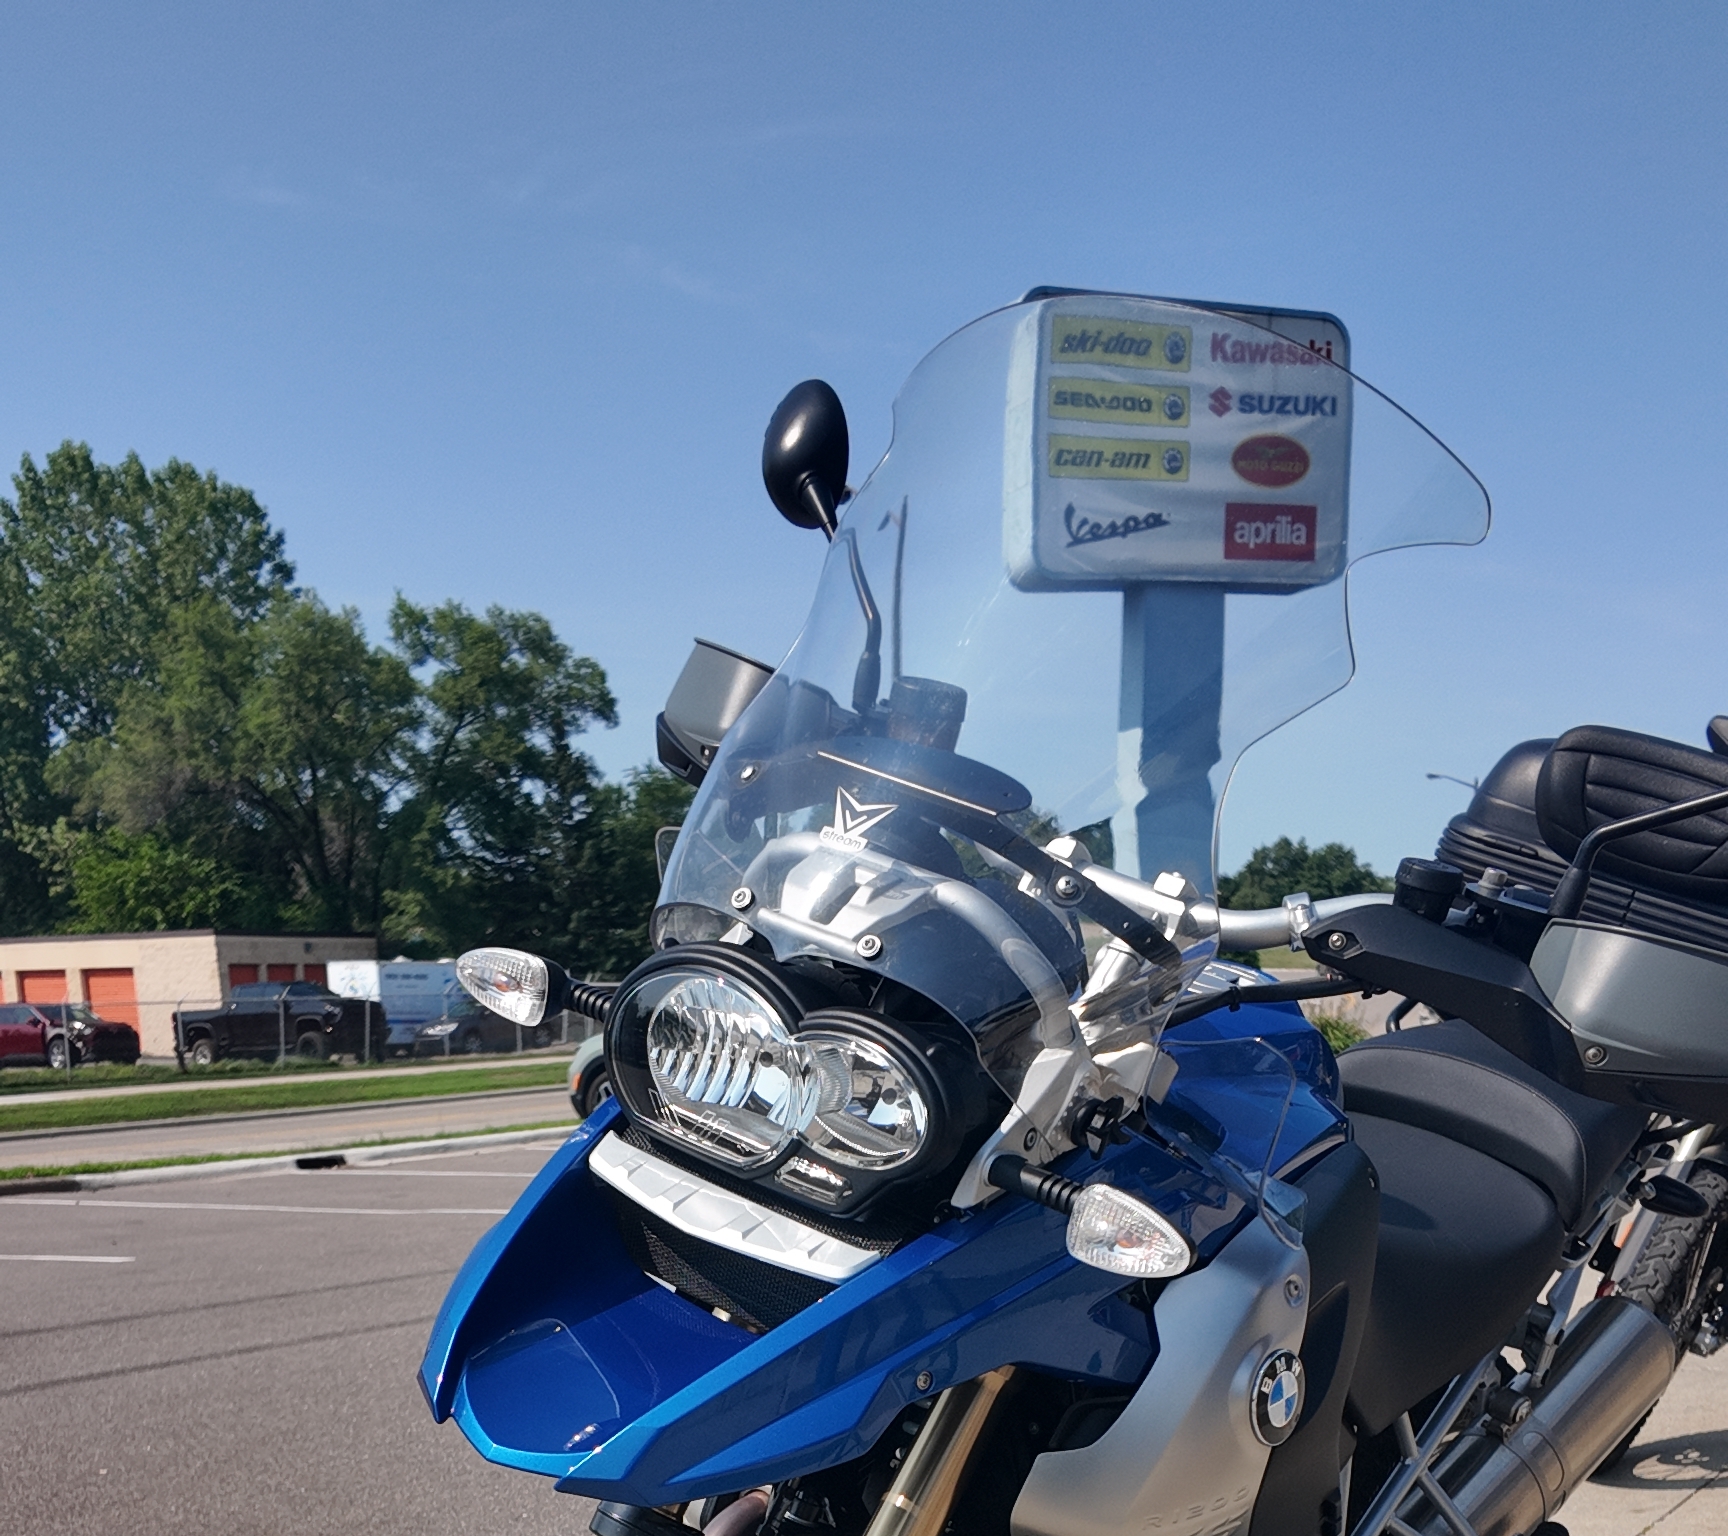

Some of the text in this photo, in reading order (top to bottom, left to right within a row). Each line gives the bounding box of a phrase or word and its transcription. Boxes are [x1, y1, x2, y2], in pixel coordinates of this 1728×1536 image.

[1060, 329, 1152, 357] ski-doo
[1209, 332, 1333, 367] Kawasaki
[1238, 394, 1337, 417] SUZUKI
[1054, 448, 1151, 469] can-am
[1064, 501, 1171, 548] Vespa
[1233, 515, 1307, 549] aprilia
[1260, 1356, 1302, 1395] BMW
